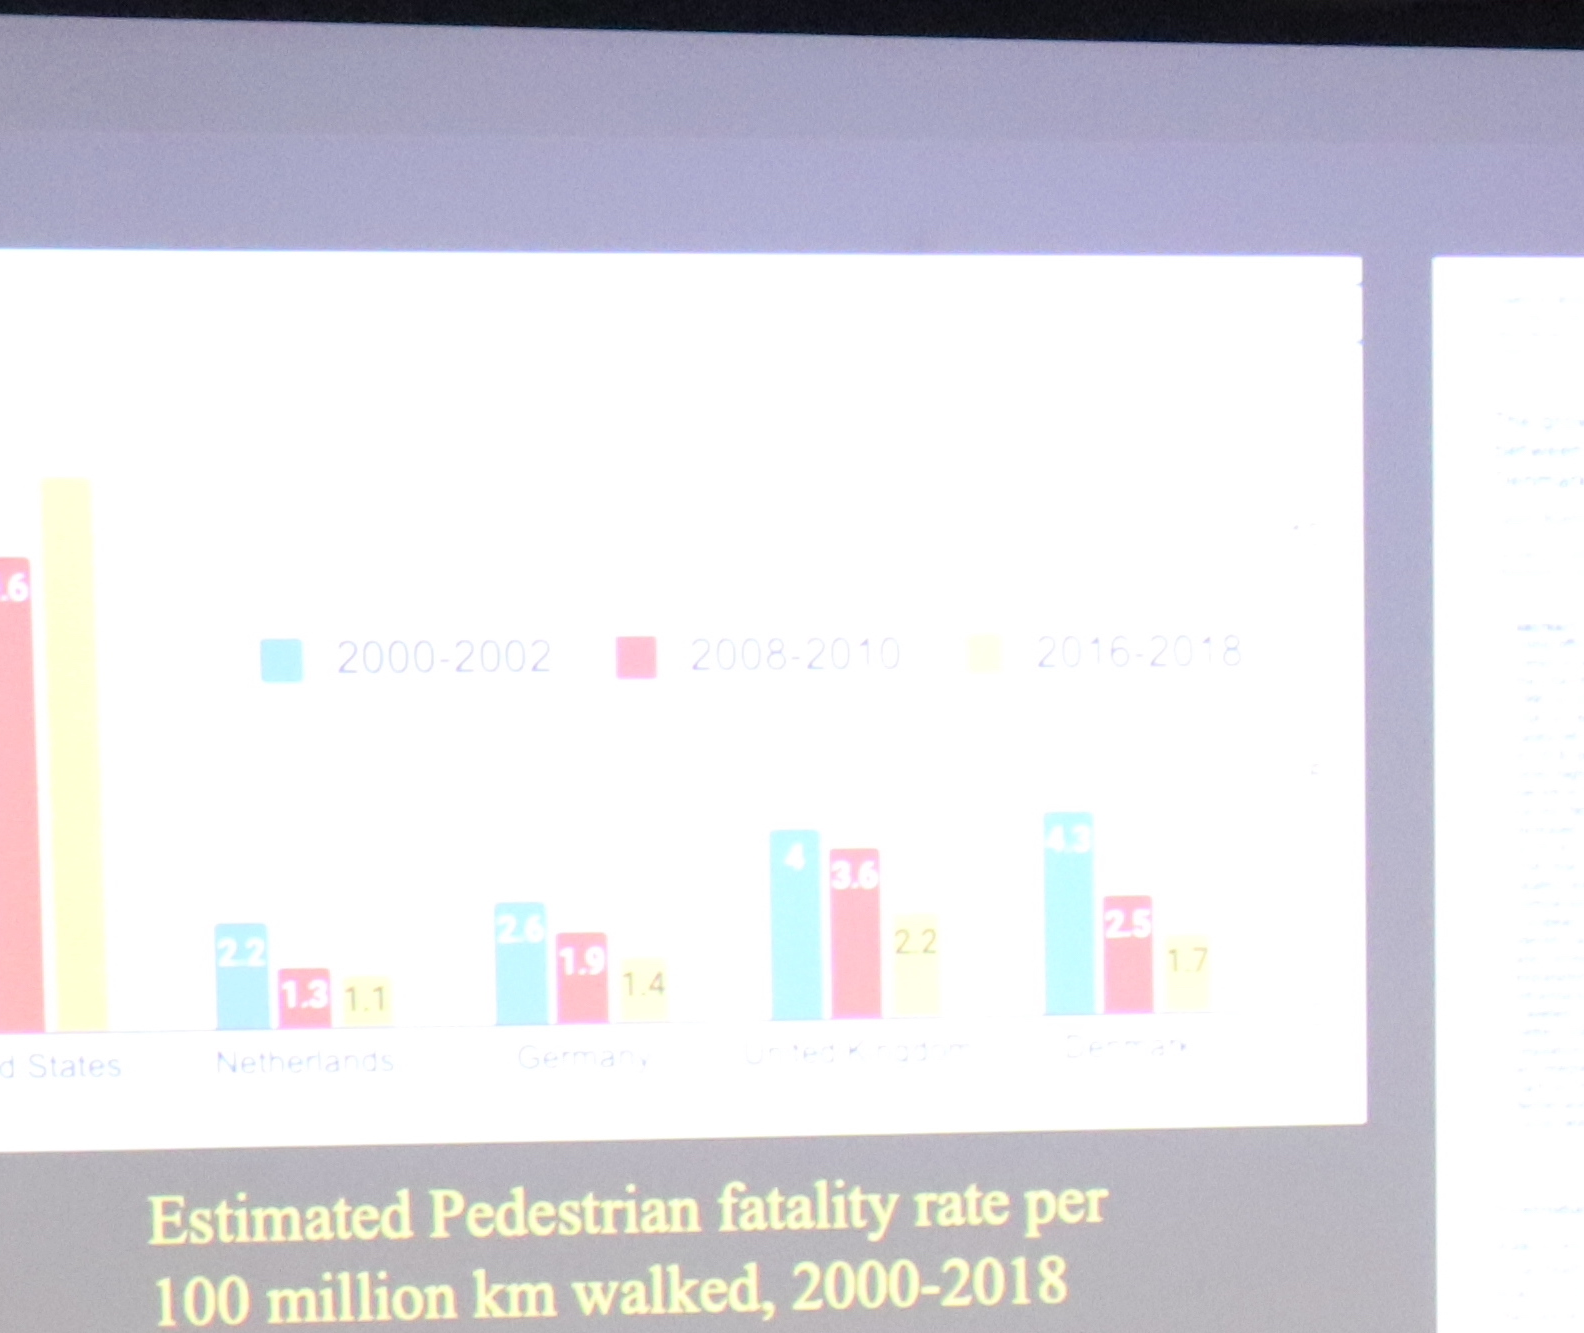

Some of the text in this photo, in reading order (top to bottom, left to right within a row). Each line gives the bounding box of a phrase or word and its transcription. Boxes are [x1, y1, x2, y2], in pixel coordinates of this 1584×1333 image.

[337, 639, 552, 675] 2000-2002
[691, 636, 901, 672] 2008-2010
[1037, 634, 1242, 669] 2016-2018
[785, 845, 804, 869] 4
[831, 861, 878, 889] 3.6
[1105, 910, 1152, 938] 2.5
[217, 938, 265, 966] 2.2
[894, 929, 937, 956] 2.2
[560, 948, 604, 976] 1.9
[283, 981, 329, 1009] 1.3
[623, 973, 666, 997] 1.4
[344, 987, 386, 1012] 1.1
[28, 1053, 121, 1079] States
[217, 1049, 394, 1076] Netherlands
[148, 1179, 1108, 1246] Estimated Pedestrian fatality rate per
[156, 1255, 1068, 1327] 100 million km walked, 2000-2018
